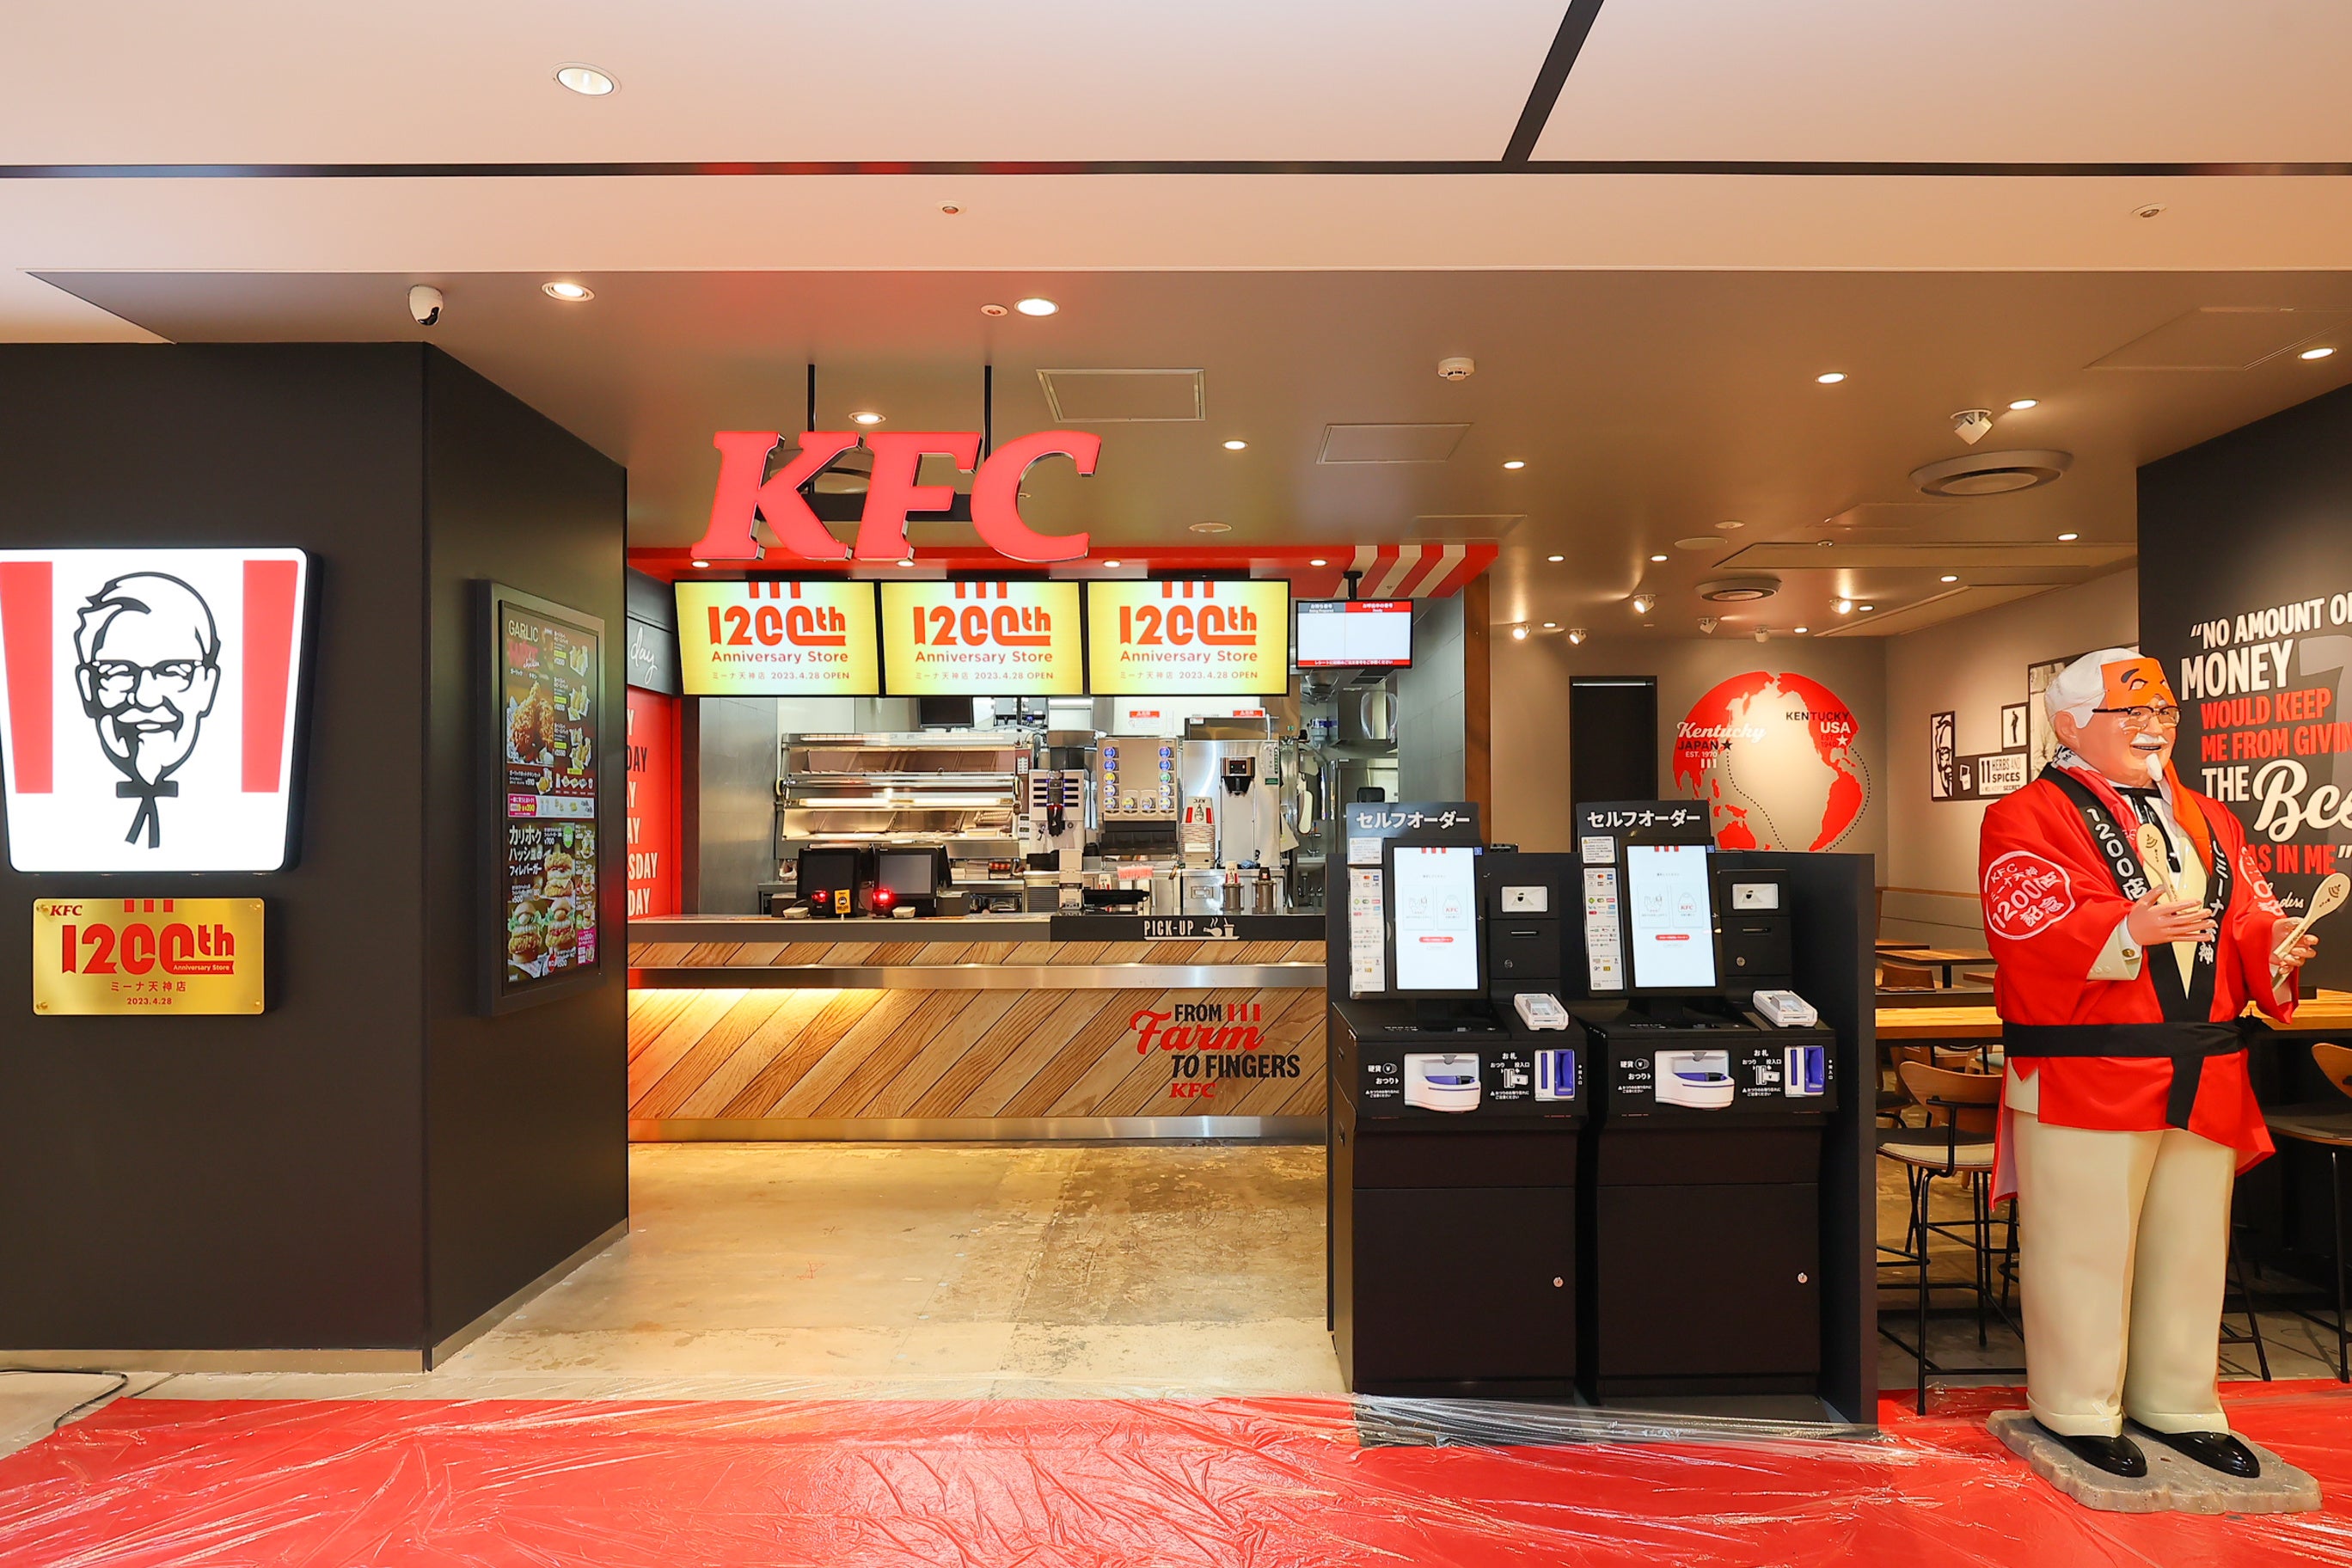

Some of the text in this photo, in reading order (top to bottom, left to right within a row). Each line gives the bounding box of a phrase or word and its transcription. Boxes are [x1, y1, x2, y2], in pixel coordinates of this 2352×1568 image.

[690, 430, 1101, 564] KFC
[508, 620, 539, 643] GARLIC
[707, 605, 847, 646] 1200th
[913, 605, 1051, 646] 1200th
[1119, 604, 1257, 646] 1200th
[2233, 597, 2325, 645] AMOUNT
[712, 651, 848, 665] Anniversary Store
[916, 651, 1053, 665] Anniversary Store
[1120, 650, 1258, 664] Anniversary Store
[712, 671, 849, 680] ミーナ天神店 2023.4.28 OPEN
[2181, 639, 2294, 701] MONEY
[1785, 712, 1850, 721] KENTUCKY
[2201, 687, 2332, 730] WOULD KEEP
[1676, 721, 1767, 743] Kentucky
[1820, 721, 1851, 734] USA
[1677, 740, 1718, 750] JAPAN
[2201, 732, 2227, 762] ME
[2232, 727, 2289, 760] FROM
[1981, 760, 1990, 783] 11
[1992, 758, 2009, 771] HERBS
[1992, 772, 2020, 783] SPICES
[2201, 765, 2250, 802] THE
[1357, 811, 1471, 829] セルフオーダー
[1587, 809, 1701, 828] セルフオーダー
[509, 824, 542, 845] カリホク
[509, 863, 542, 876] フィレバーガー
[2276, 845, 2300, 874] IN
[1990, 863, 2018, 884] KFC
[50, 904, 83, 916] KFC
[1993, 871, 2063, 928] 1200店
[1143, 920, 1194, 936] PICK-UP
[62, 922, 235, 975] 1200th
[111, 981, 187, 992] ミーナ天神店
[127, 997, 172, 1006] 2023.4.28
[1174, 1004, 1222, 1022] FROM
[1130, 1009, 1265, 1055] Farm
[1171, 1054, 1301, 1079] TO FINGERS
[1169, 1082, 1216, 1099] KFC
